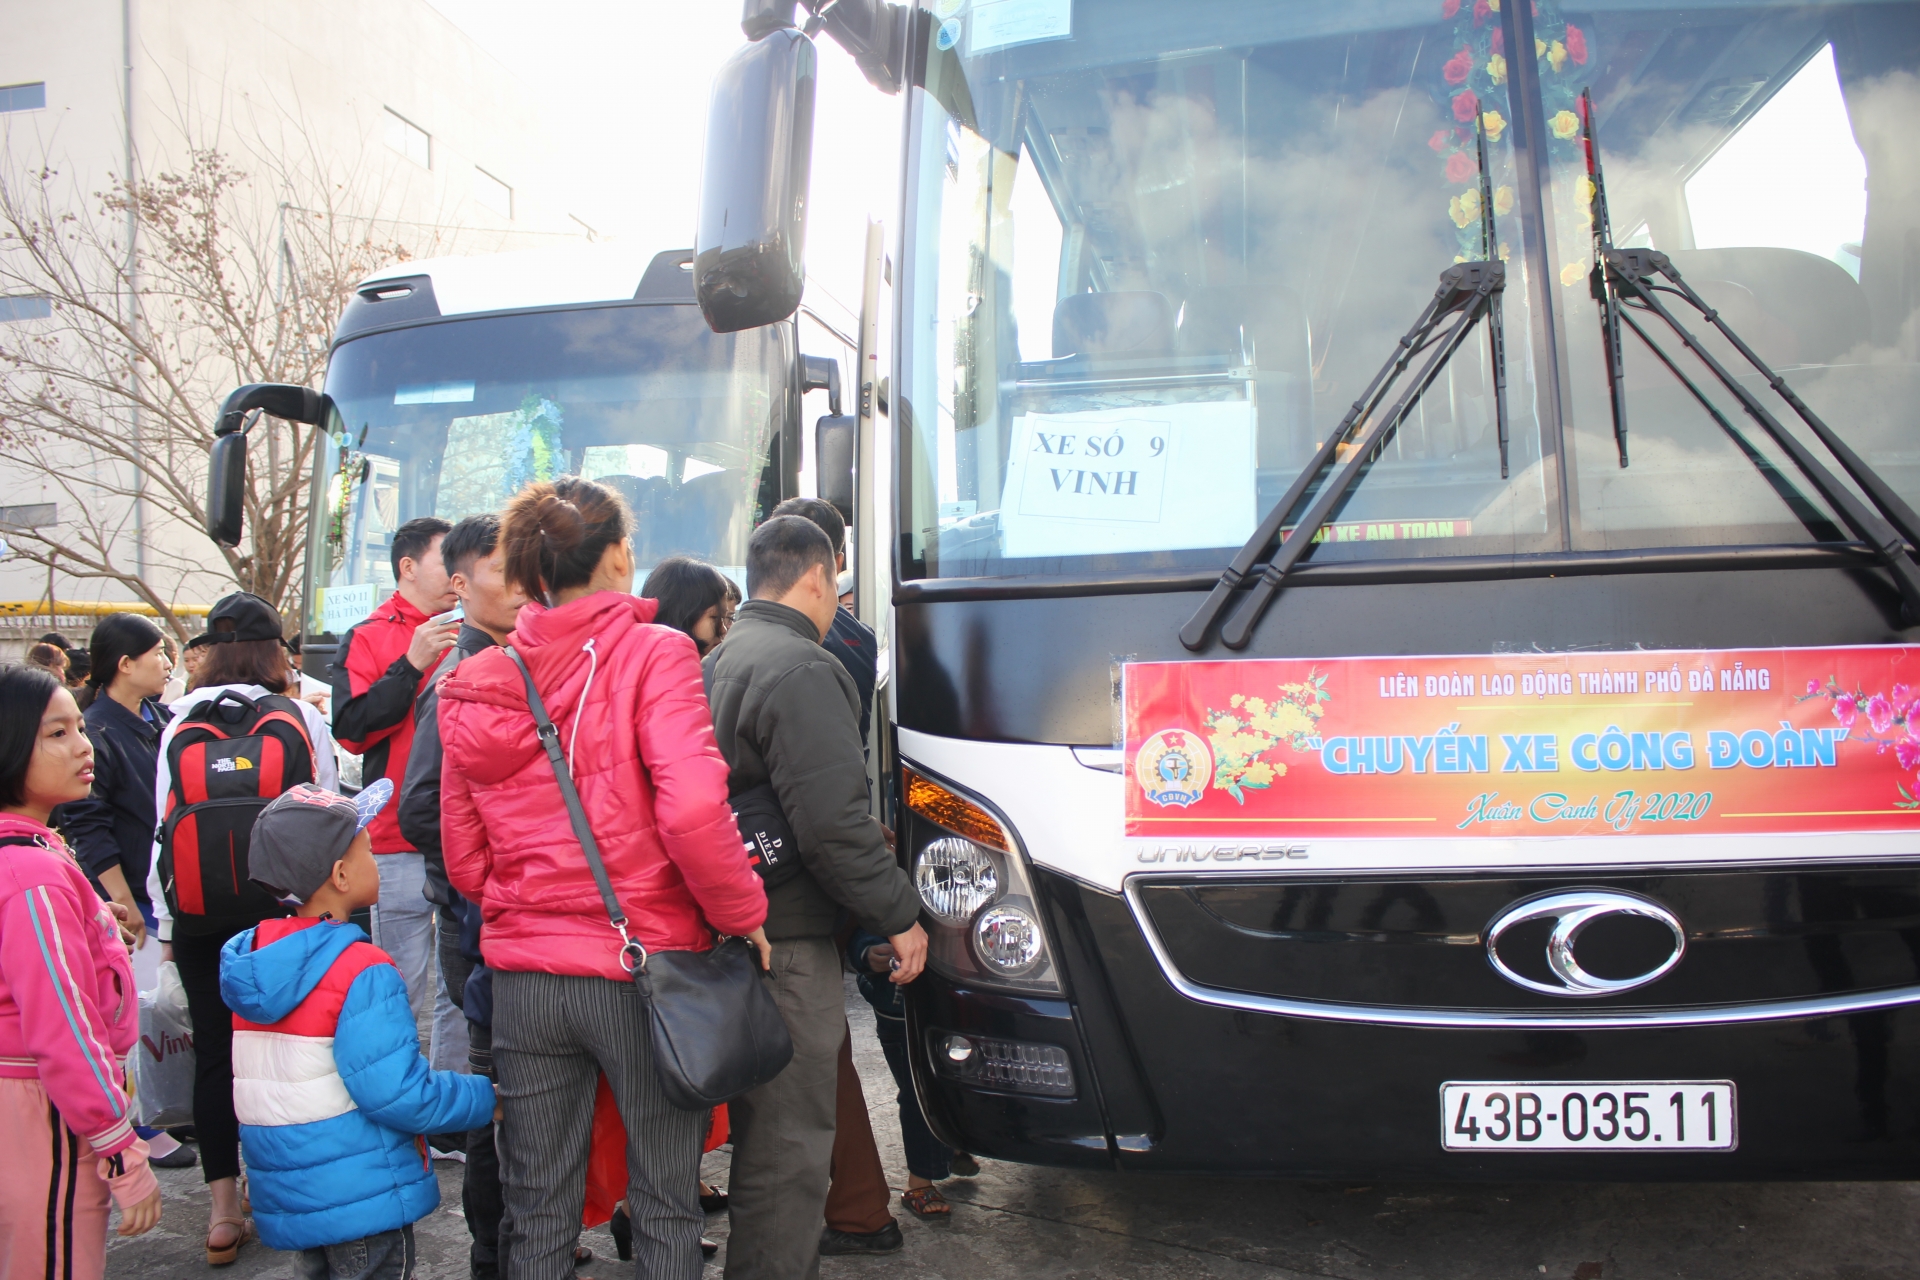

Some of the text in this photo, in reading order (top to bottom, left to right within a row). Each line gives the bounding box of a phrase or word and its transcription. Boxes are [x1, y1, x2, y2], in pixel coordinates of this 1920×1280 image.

[1032, 428, 1165, 457] XE SỐ 9
[1049, 468, 1140, 496] VINH
[1336, 525, 1361, 543] XE
[1366, 523, 1395, 541] AN
[328, 593, 341, 606] XE
[359, 591, 368, 602] 11
[1379, 662, 1771, 700] LIÊN ĐOÀN LAO ĐỘNG THÀNH PHỐ ĐÀ NẴNG
[1500, 733, 1559, 773] XE
[1570, 724, 1695, 772] CÔNG
[1161, 792, 1188, 803] CĐVN
[1456, 789, 1713, 831] Xuân Canh Tý 2020
[759, 831, 778, 863] DIEKE
[772, 837, 783, 848] D
[1137, 842, 1311, 863] UNIVERSE
[1453, 1091, 1717, 1142] 43B-035.11
